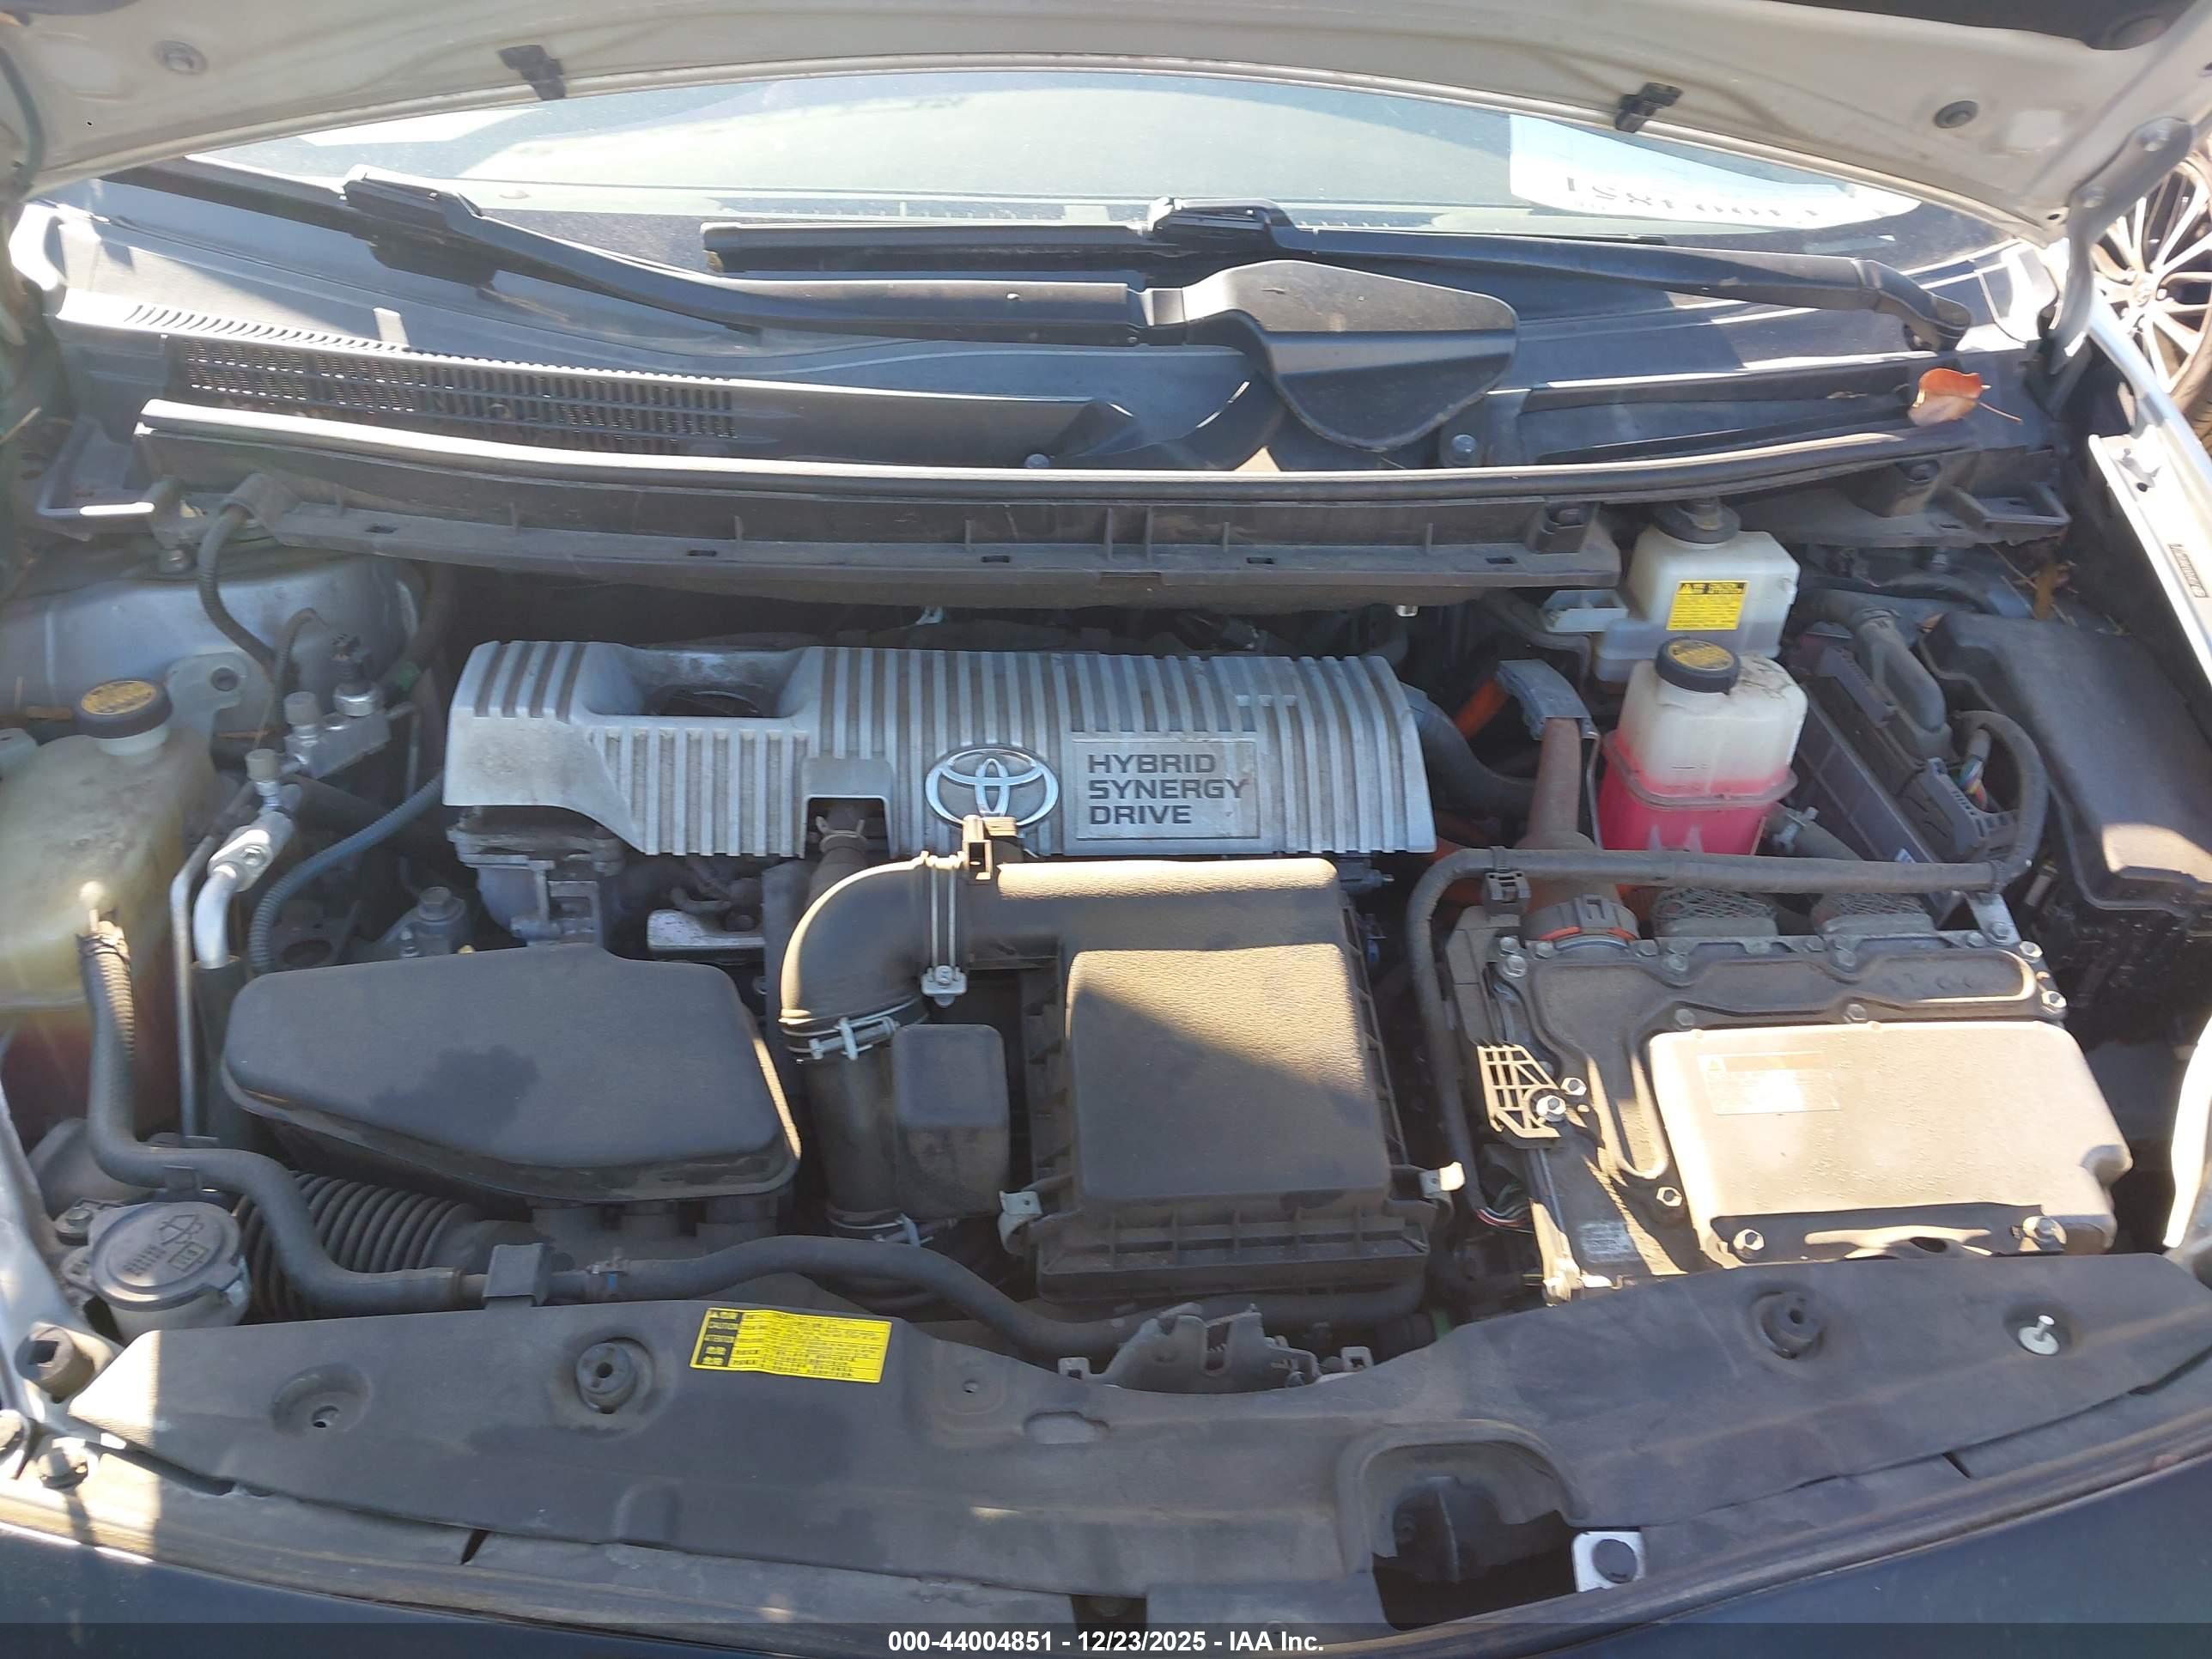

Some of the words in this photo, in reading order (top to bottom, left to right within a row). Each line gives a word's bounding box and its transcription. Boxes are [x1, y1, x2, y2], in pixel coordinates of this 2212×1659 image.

[1087, 754, 1217, 774] HYBRID
[1088, 778, 1250, 799] SYNERGY
[1089, 805, 1193, 825] DRIVE
